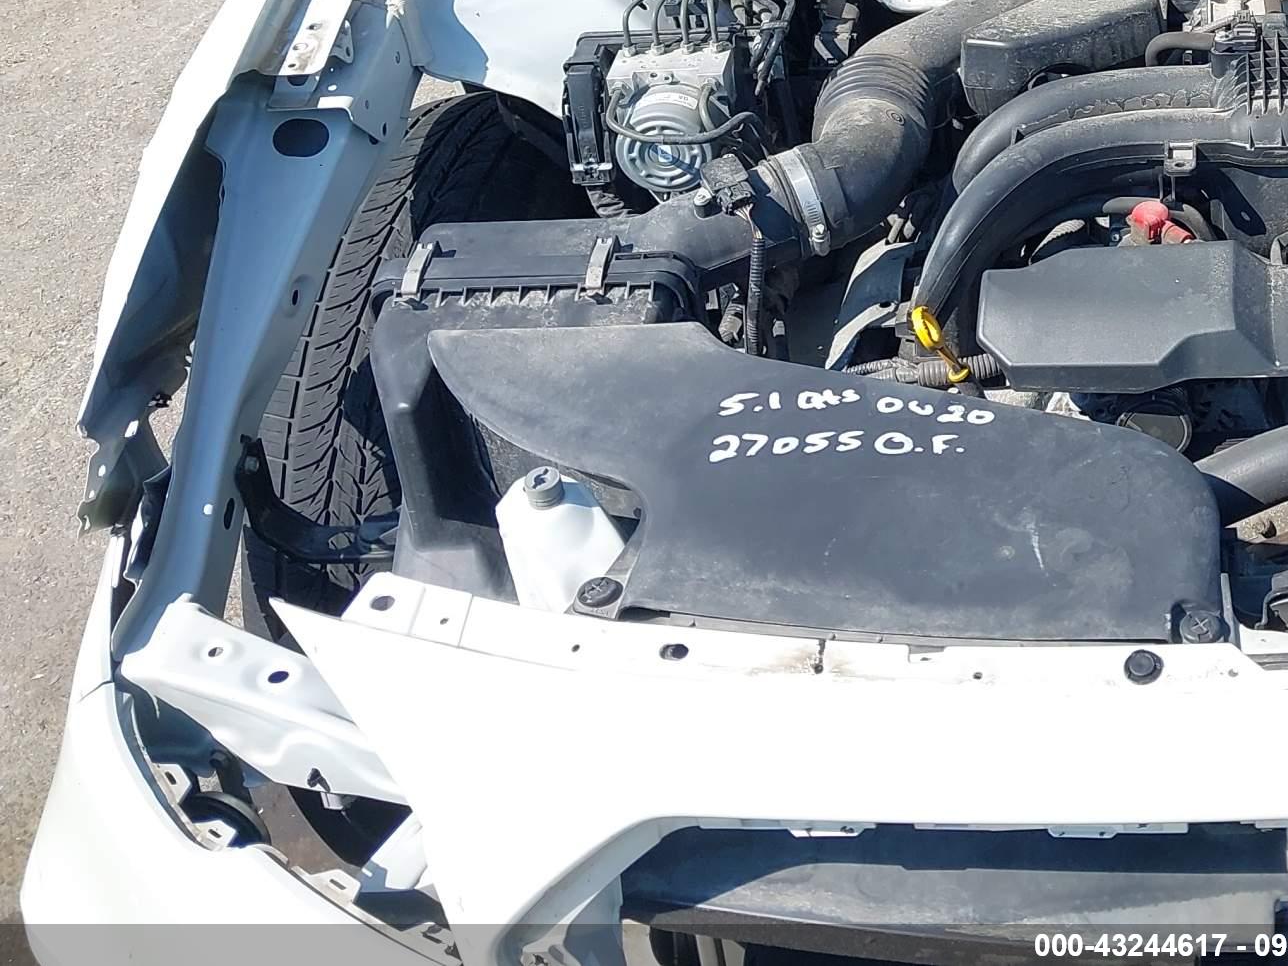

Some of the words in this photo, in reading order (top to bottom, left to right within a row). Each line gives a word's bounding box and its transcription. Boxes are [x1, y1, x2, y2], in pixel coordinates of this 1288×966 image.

[718, 392, 782, 416] 5.1
[797, 389, 861, 410] Qts
[709, 430, 865, 462] 27055
[873, 432, 966, 455] O.F.
